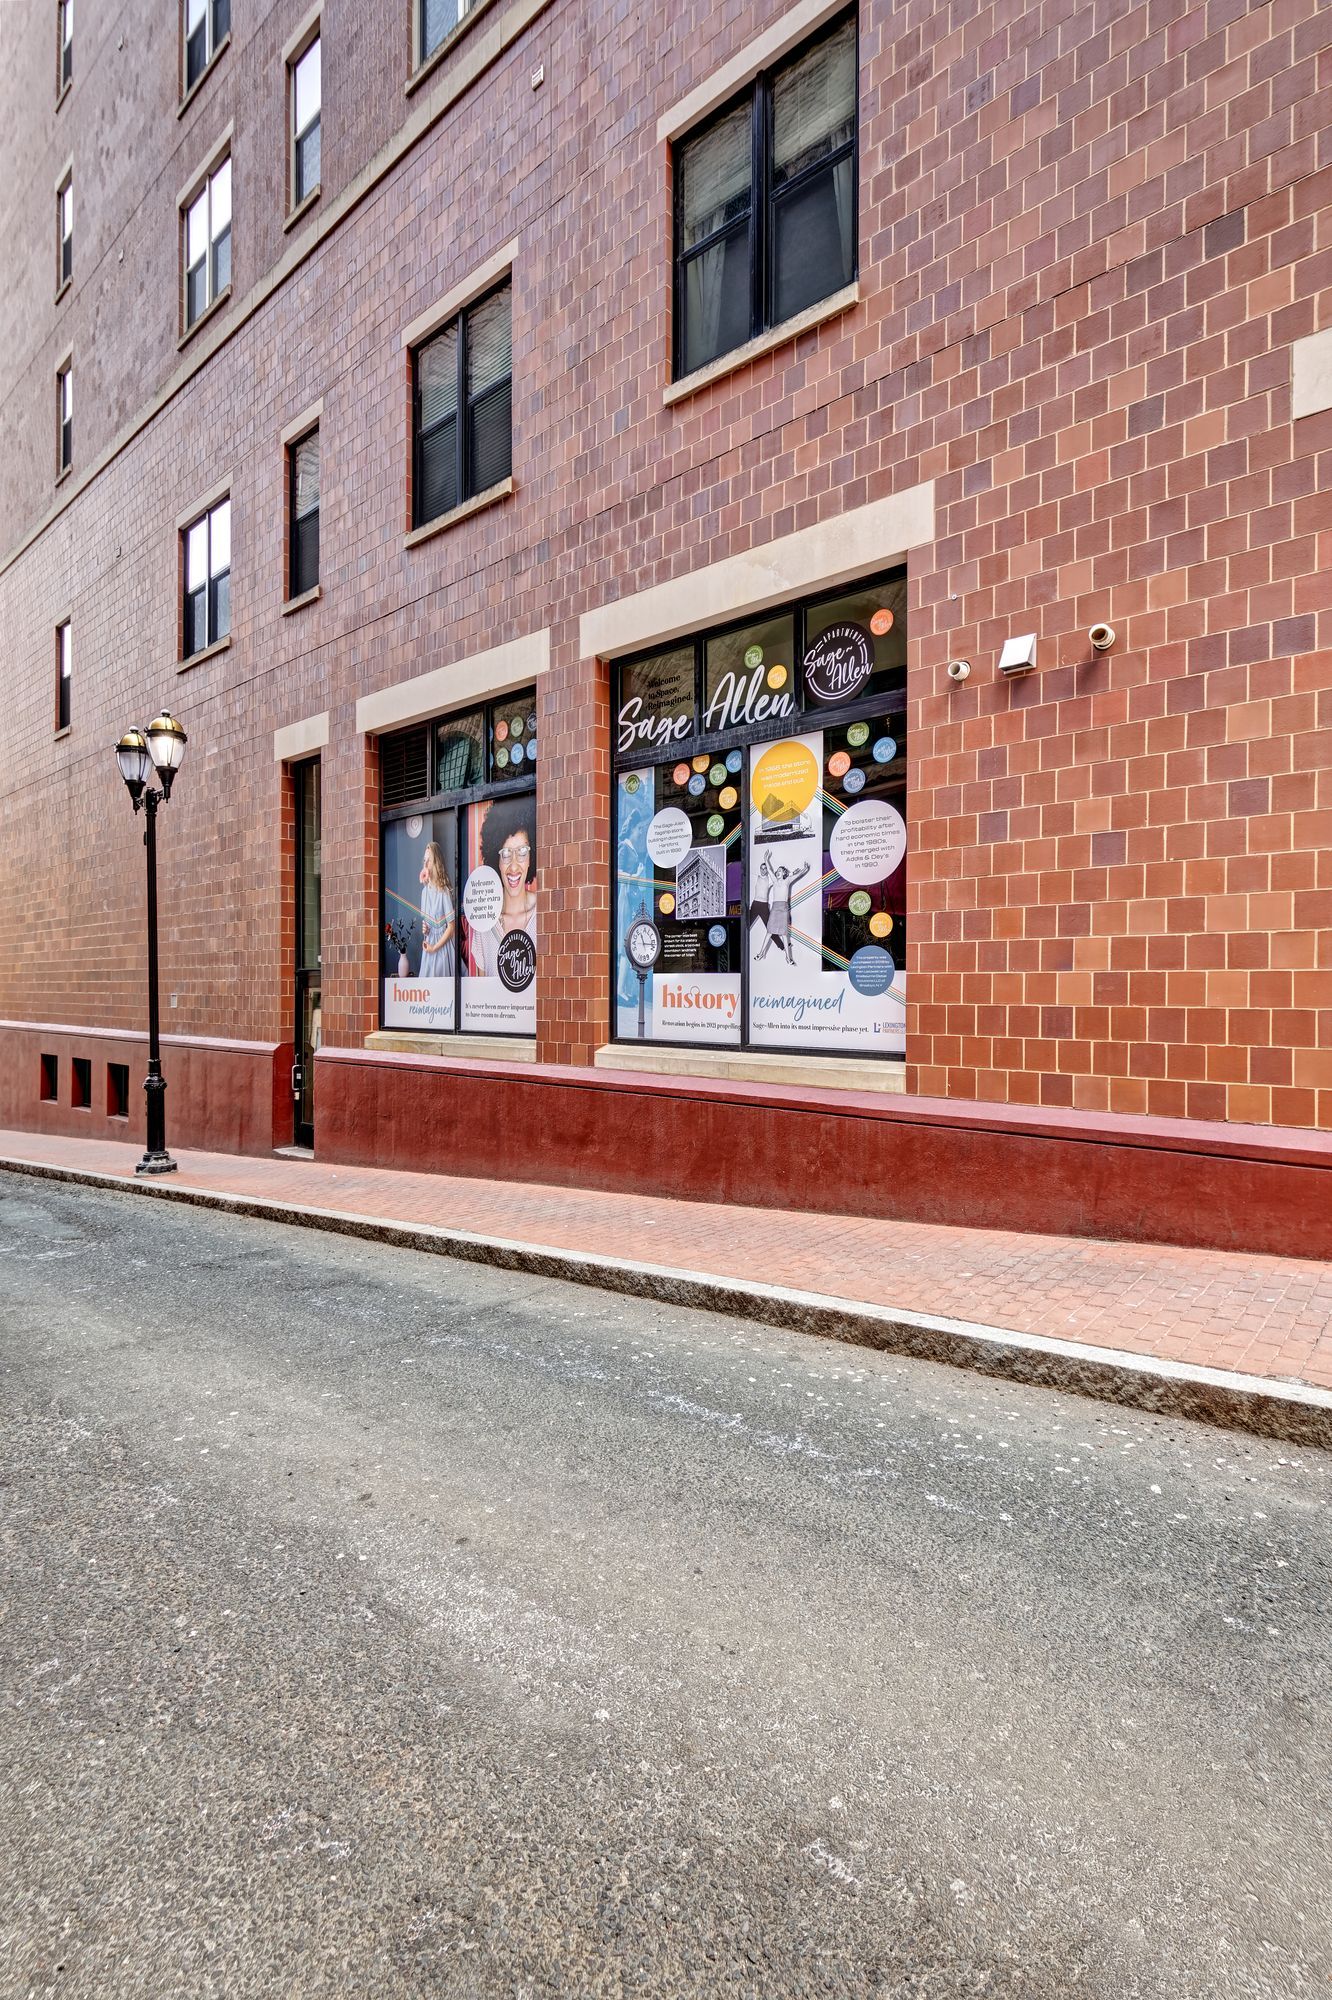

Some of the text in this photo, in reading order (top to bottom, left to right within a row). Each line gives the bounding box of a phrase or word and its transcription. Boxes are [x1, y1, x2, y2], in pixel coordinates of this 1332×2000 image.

[823, 627, 865, 645] APARTMENTS
[828, 655, 874, 690] Allen
[647, 674, 681, 688] Welcome
[648, 692, 693, 711] Reimagined.
[618, 664, 795, 752] Sage Allen
[852, 817, 875, 825] bolster
[840, 825, 877, 835] profitability
[851, 831, 880, 840] economic
[881, 829, 900, 837] times
[840, 849, 855, 857] they
[855, 846, 880, 855] merged
[485, 888, 494, 896] you
[465, 897, 477, 905] have
[473, 905, 487, 913] space
[511, 956, 536, 980] Allen
[393, 983, 431, 1002] home
[662, 984, 740, 1018] history
[752, 988, 845, 1022] reimagined
[409, 999, 454, 1024] reimagined
[511, 1003, 535, 1012] important
[686, 1020, 700, 1029] begins
[752, 1022, 780, 1030] Sage-Allen
[780, 1022, 790, 1030] into
[812, 1023, 841, 1032] impressive
[841, 1024, 859, 1033] phase
